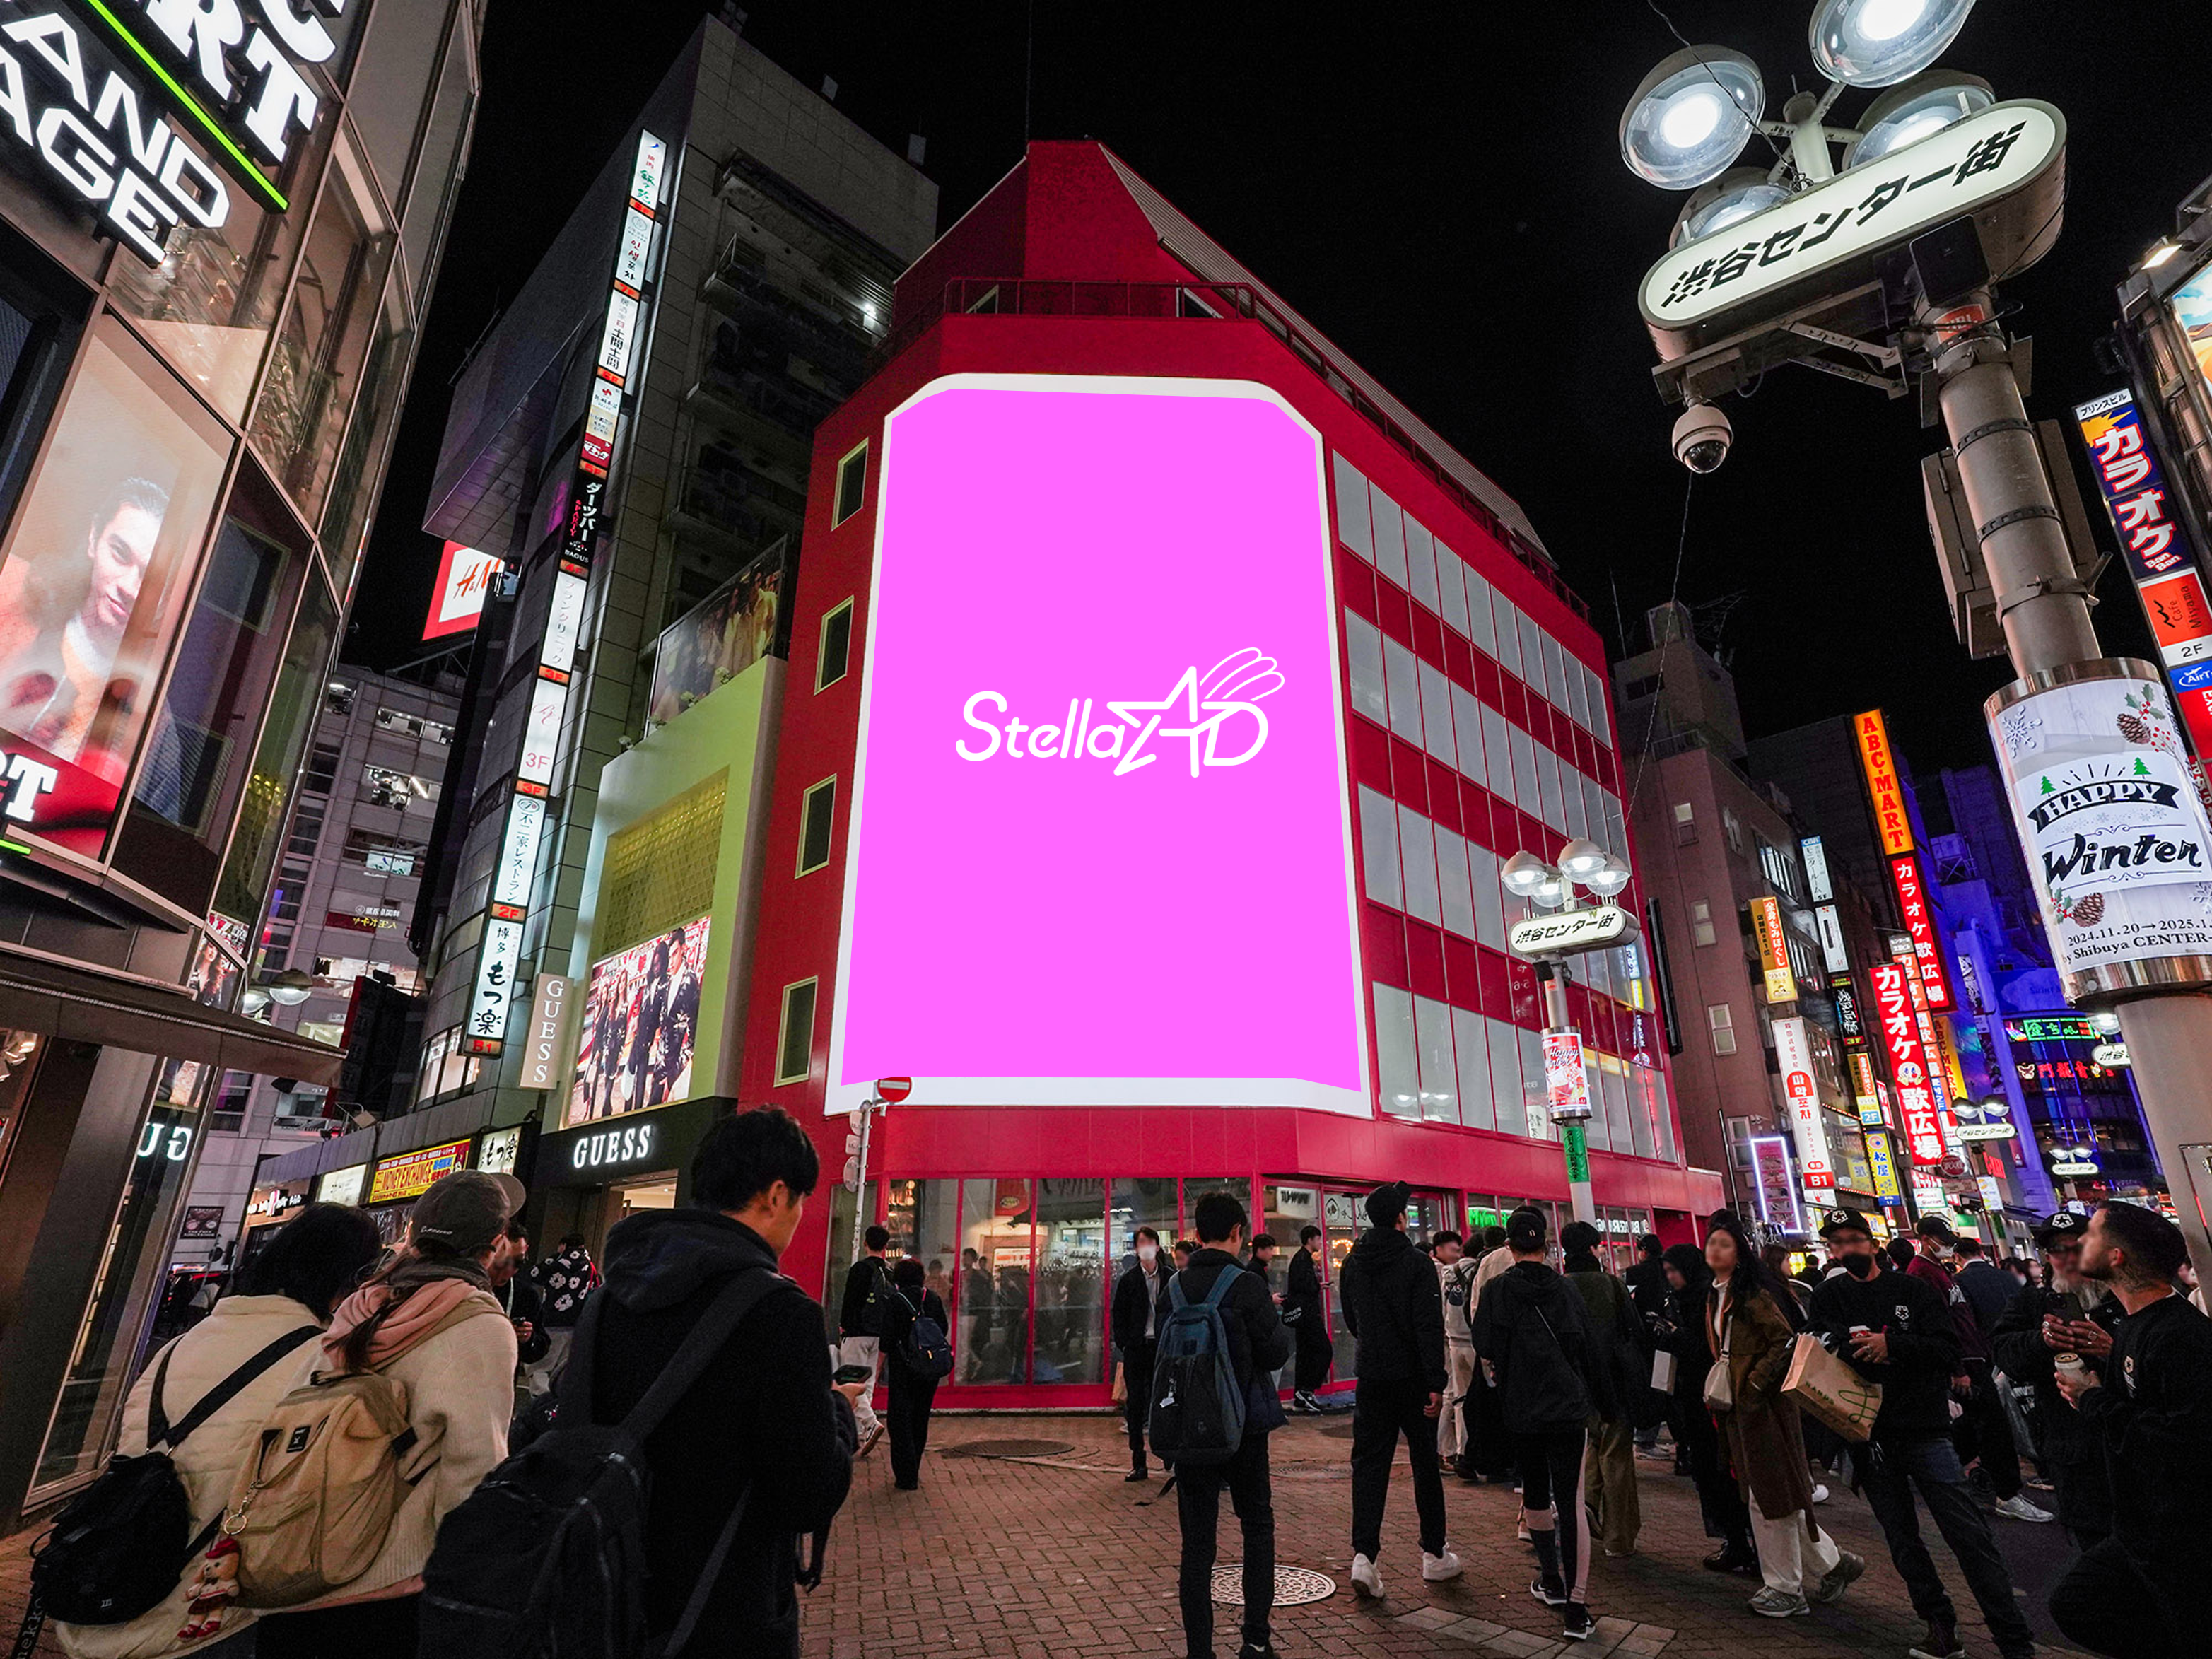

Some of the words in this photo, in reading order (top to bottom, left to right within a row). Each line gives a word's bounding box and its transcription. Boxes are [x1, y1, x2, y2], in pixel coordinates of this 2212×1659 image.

[1661, 120, 2027, 308] 渋谷センター街
[619, 283, 636, 297] 7F
[607, 327, 625, 370] 土間土間
[2079, 392, 2128, 418] プリンスビル
[2094, 423, 2176, 558] カラオケ
[579, 481, 602, 541] ダーツバー
[2144, 551, 2171, 569] Ban
[2156, 555, 2182, 572] Ban
[453, 558, 502, 599] H&M
[2181, 643, 2204, 657] 2F
[544, 668, 564, 682] 3F
[525, 751, 551, 770] 3F
[522, 782, 544, 796] 3F
[2042, 780, 2163, 823] HAPPY
[506, 812, 534, 902] 不二家レストラン
[2042, 832, 2203, 886] Winter
[498, 905, 520, 920] 2F
[1515, 913, 1616, 944] 渋谷センター街
[496, 926, 510, 954] 博多
[1765, 901, 1786, 967] 全身もみほぐし
[1897, 864, 1945, 1002] カラオケ歌広場
[2073, 942, 2130, 959] Shibuya
[474, 960, 506, 1035] もつ楽
[472, 1039, 493, 1053] B1
[534, 979, 565, 1083] GUESS
[1875, 966, 1917, 1061] カラオケ
[1900, 1086, 1943, 1160] 歌広場
[1792, 1074, 1811, 1120] 마약포차
[1863, 1112, 1878, 1122] 2F
[573, 1125, 651, 1168] GUESS
[1810, 1176, 1827, 1187] B1
